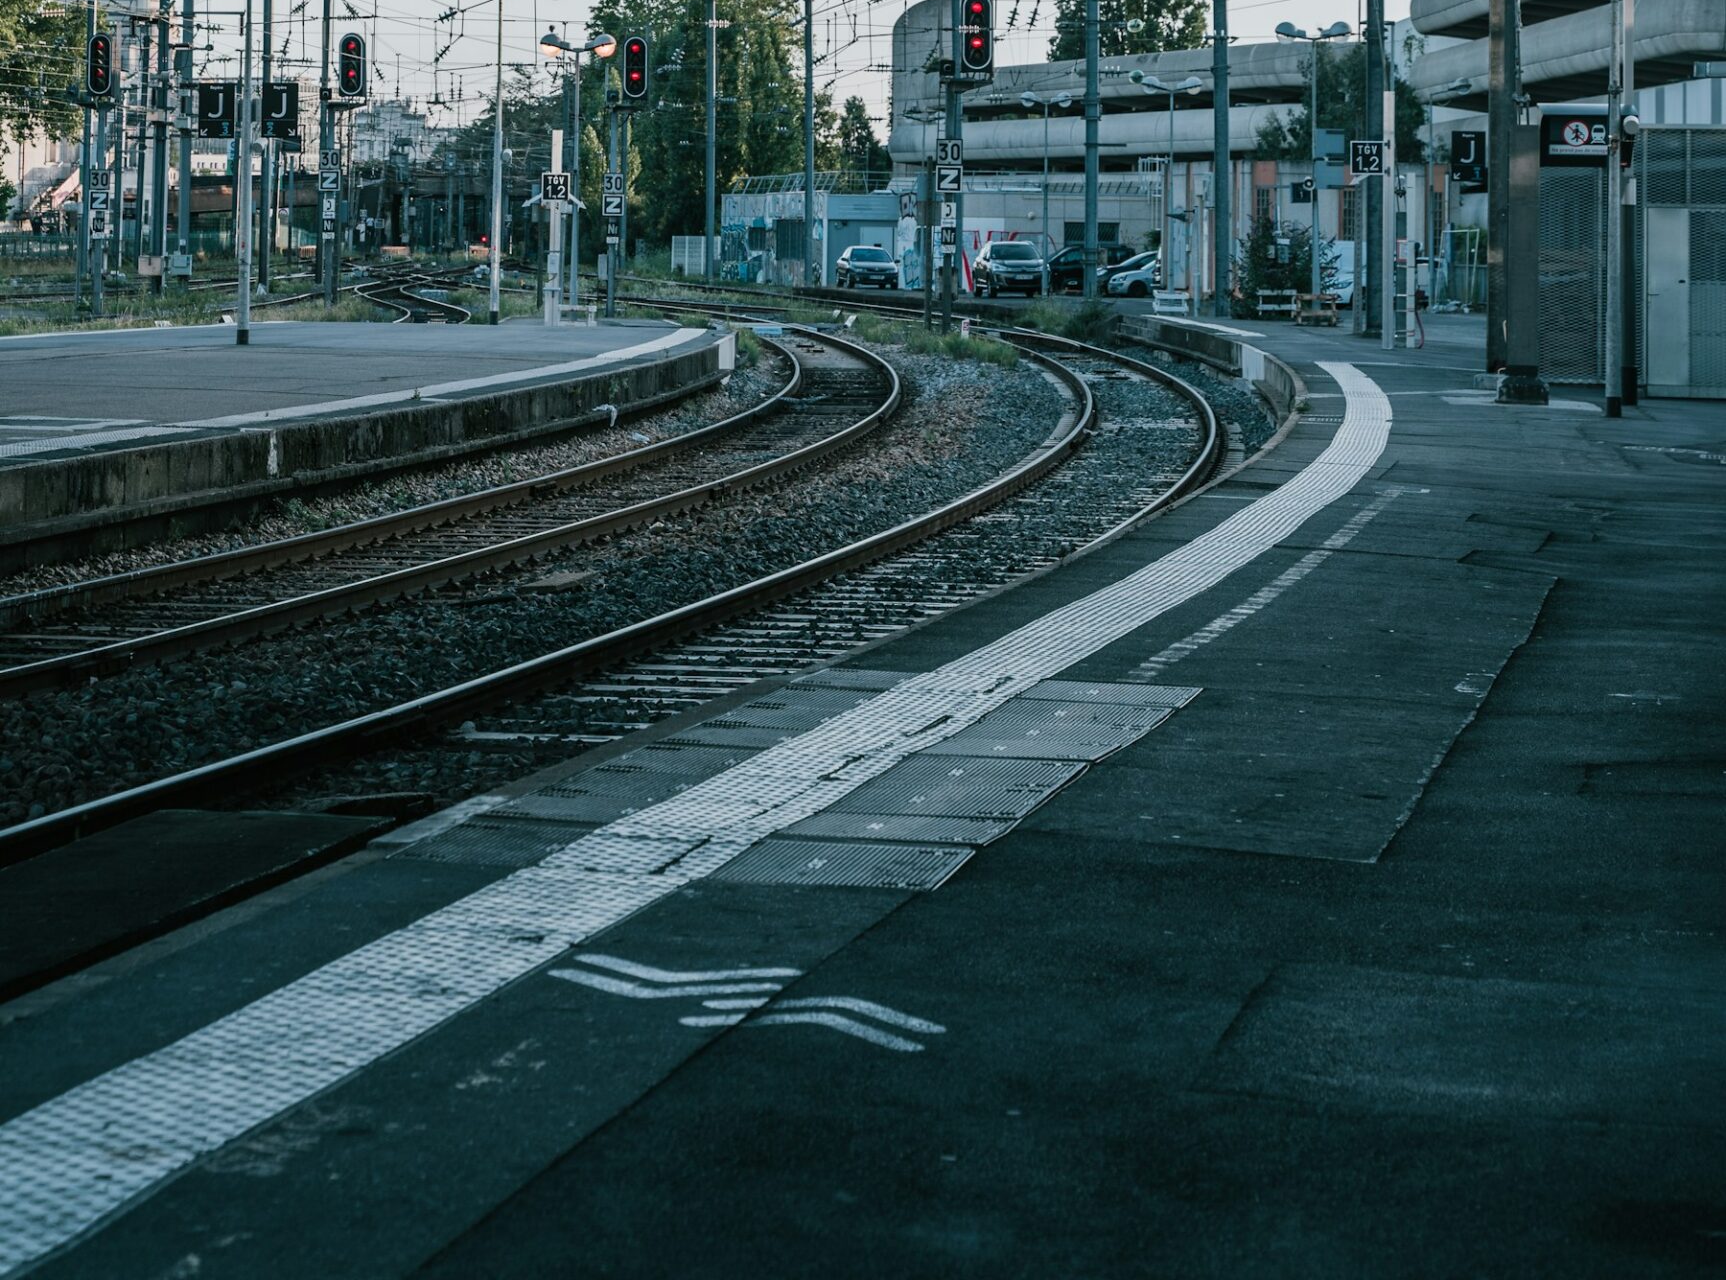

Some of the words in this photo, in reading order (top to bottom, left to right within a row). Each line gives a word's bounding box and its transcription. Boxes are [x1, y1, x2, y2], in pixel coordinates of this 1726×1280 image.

[207, 92, 224, 119] J
[270, 92, 287, 119] J
[267, 126, 274, 134] 2
[939, 143, 960, 161] 30
[1356, 144, 1378, 155] TGV
[1460, 140, 1475, 164] J
[321, 152, 339, 166] 30
[91, 172, 109, 187] 30
[322, 172, 337, 189] Z
[547, 176, 565, 184] TGV
[605, 176, 623, 191] 30
[940, 169, 959, 189] Z
[91, 193, 107, 209] Z
[605, 197, 621, 213] Z
